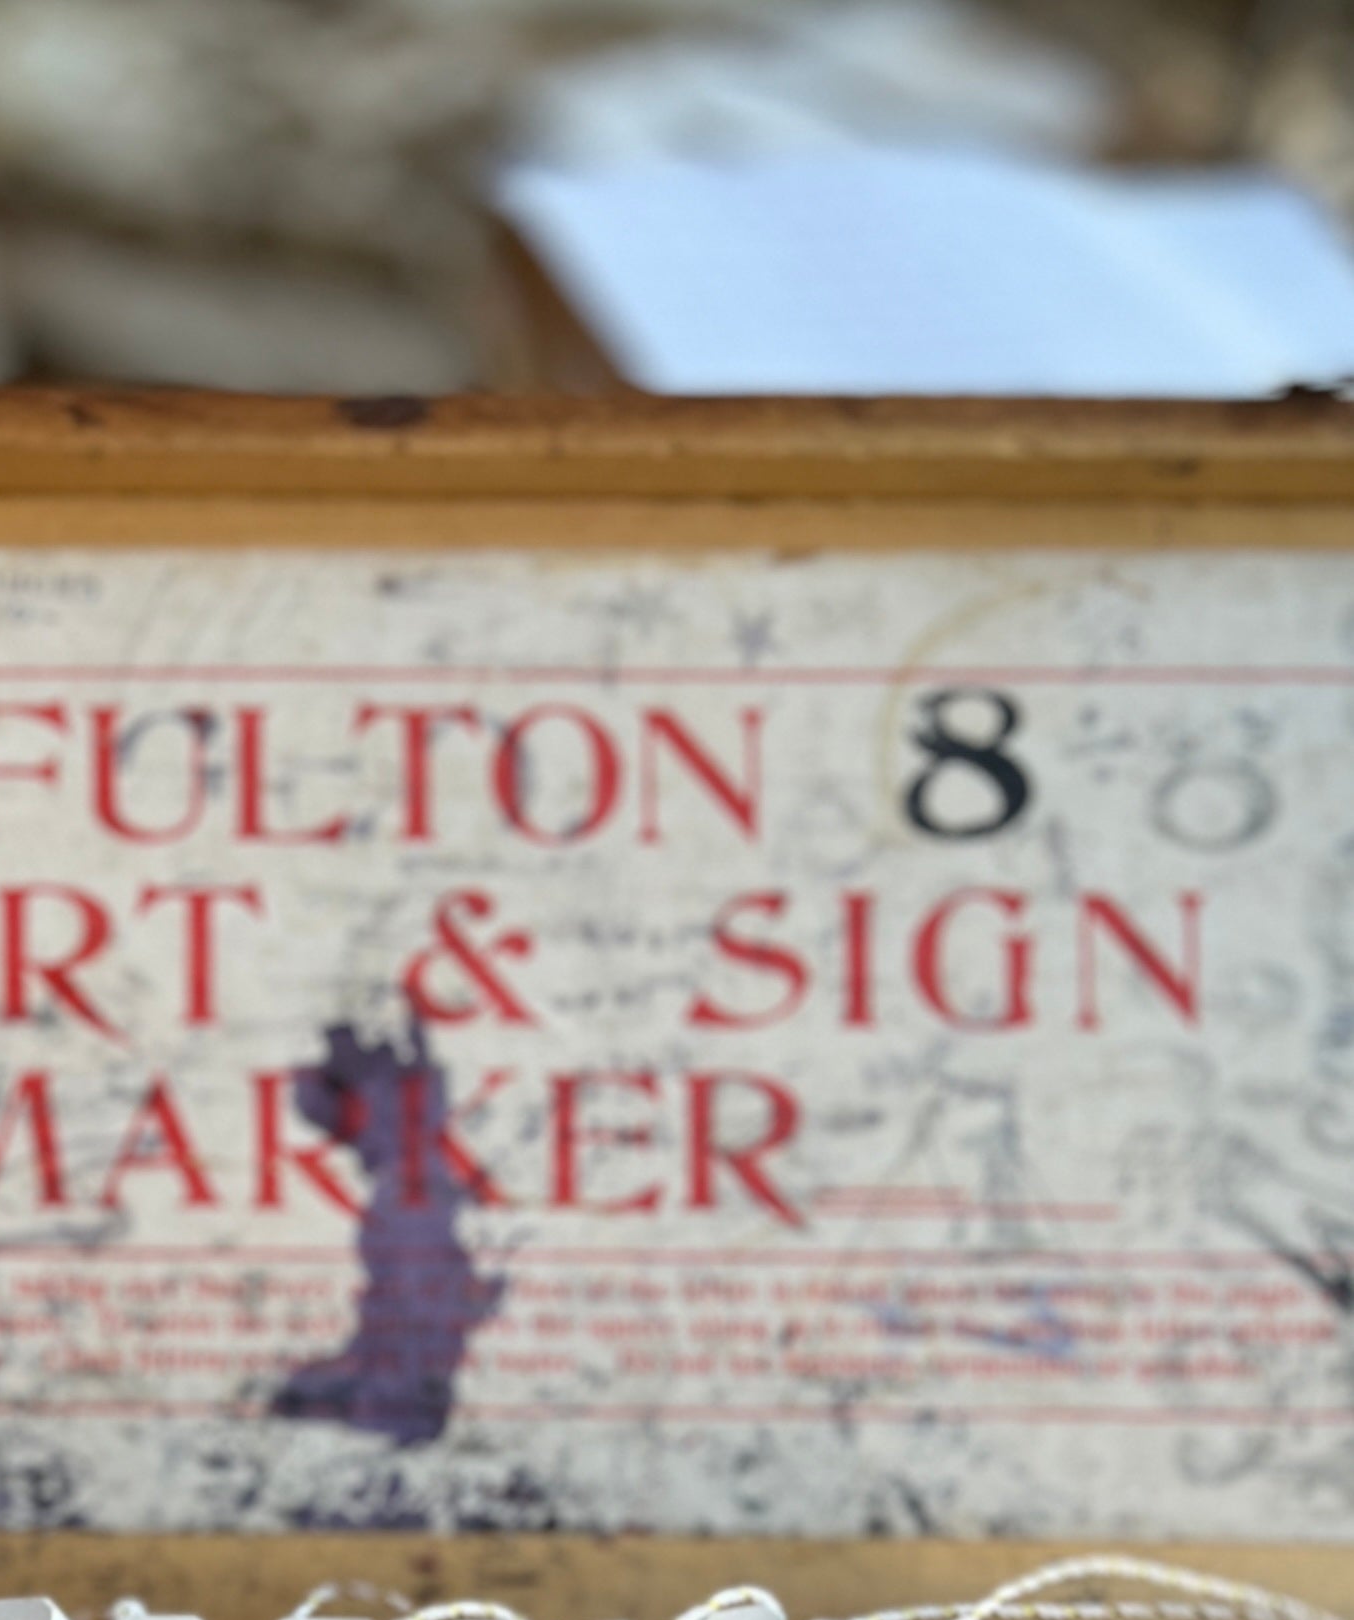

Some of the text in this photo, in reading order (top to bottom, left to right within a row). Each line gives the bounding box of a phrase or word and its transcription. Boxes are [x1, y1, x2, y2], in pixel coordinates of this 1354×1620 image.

[902, 683, 1034, 846] 8
[401, 885, 543, 1032] &
[684, 888, 1203, 1034] SIGN
